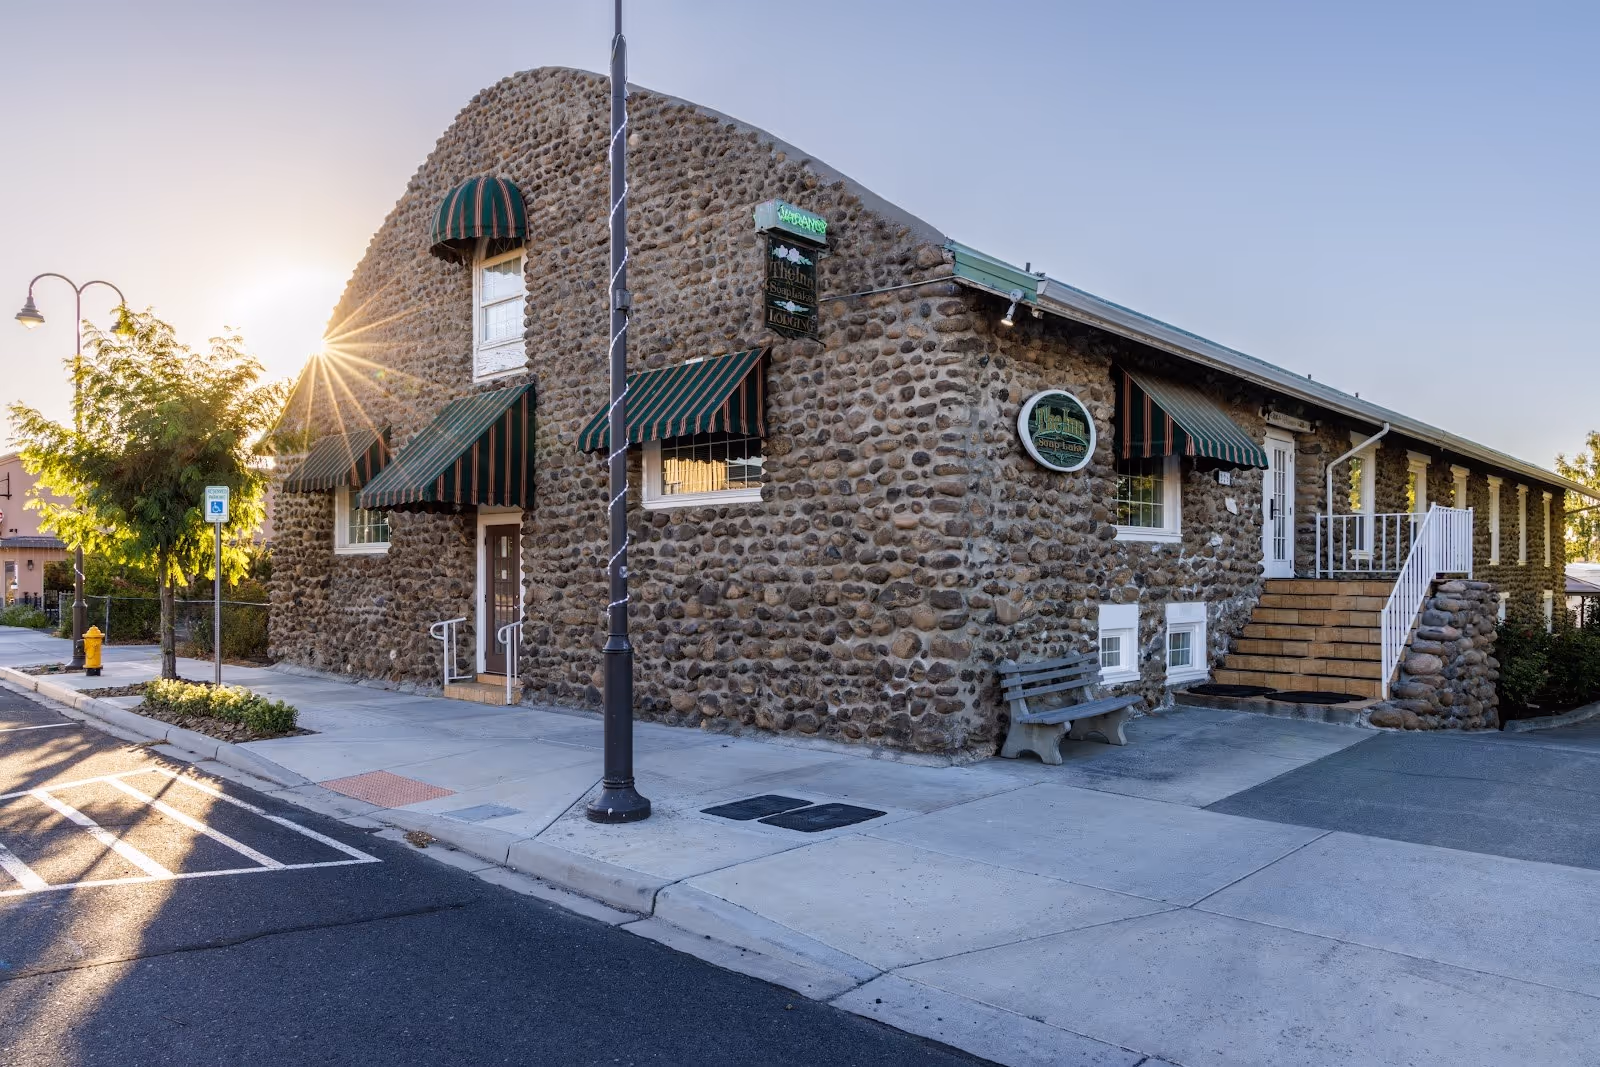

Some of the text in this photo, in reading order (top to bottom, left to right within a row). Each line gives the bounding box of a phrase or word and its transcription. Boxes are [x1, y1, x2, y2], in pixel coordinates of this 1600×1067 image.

[769, 261, 814, 289] The Inn
[769, 281, 792, 299] Soap
[791, 287, 814, 303] Lake
[1035, 404, 1086, 439] The Inn
[1038, 438, 1085, 453] Soap Lake
